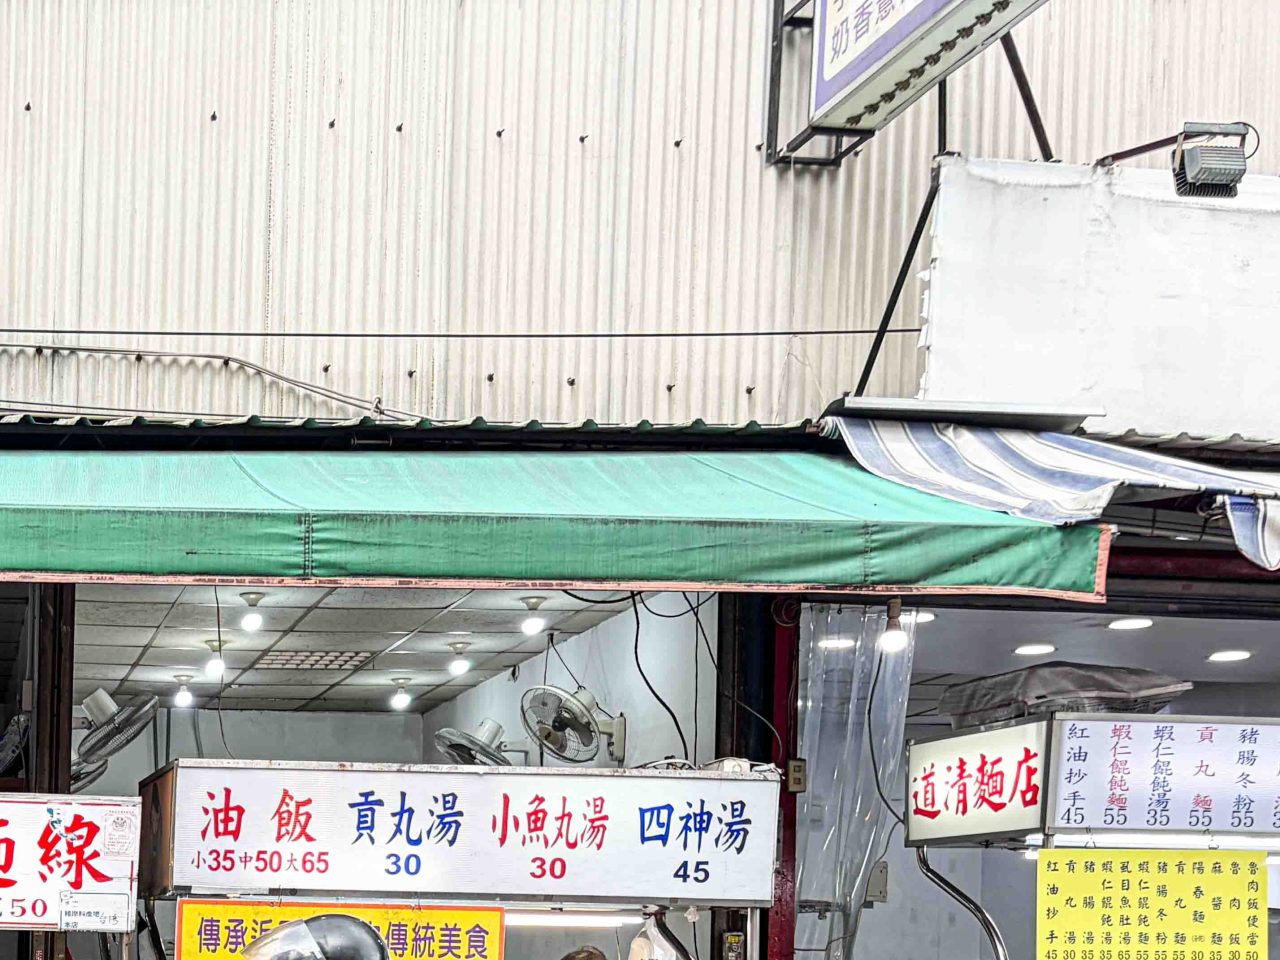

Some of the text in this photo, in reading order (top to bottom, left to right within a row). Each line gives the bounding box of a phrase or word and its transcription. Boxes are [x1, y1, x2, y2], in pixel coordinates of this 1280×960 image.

[912, 746, 1040, 820] 道清麵店
[1060, 723, 1090, 825] 紅油抄手 45
[1103, 724, 1133, 825] 蝦仁餛飩麵 55
[1146, 725, 1175, 826] 蝦仁餛飩湯 35
[1188, 726, 1218, 827] 貢丸麵 55
[1230, 727, 1260, 828] 豬腸冬粉 55
[200, 786, 317, 844] 油飯
[348, 790, 464, 848] 貢丸湯
[492, 793, 608, 852] 小魚丸湯
[639, 799, 752, 854] 四神湯
[384, 854, 422, 877] 30
[530, 857, 568, 880] 30
[674, 861, 710, 884] 45
[10, 898, 48, 917] 50
[1063, 859, 1077, 960] 貢丸湯 30
[1172, 861, 1187, 960] 貢丸麵 55
[1044, 949, 1058, 960] 45
[1081, 949, 1094, 960] 35
[1099, 949, 1112, 960] 35
[1117, 950, 1131, 960] 65
[1136, 950, 1149, 960] 55
[1154, 950, 1167, 960] 55
[1191, 951, 1204, 960] 30
[1209, 951, 1222, 960] 35
[1228, 950, 1241, 960] 30
